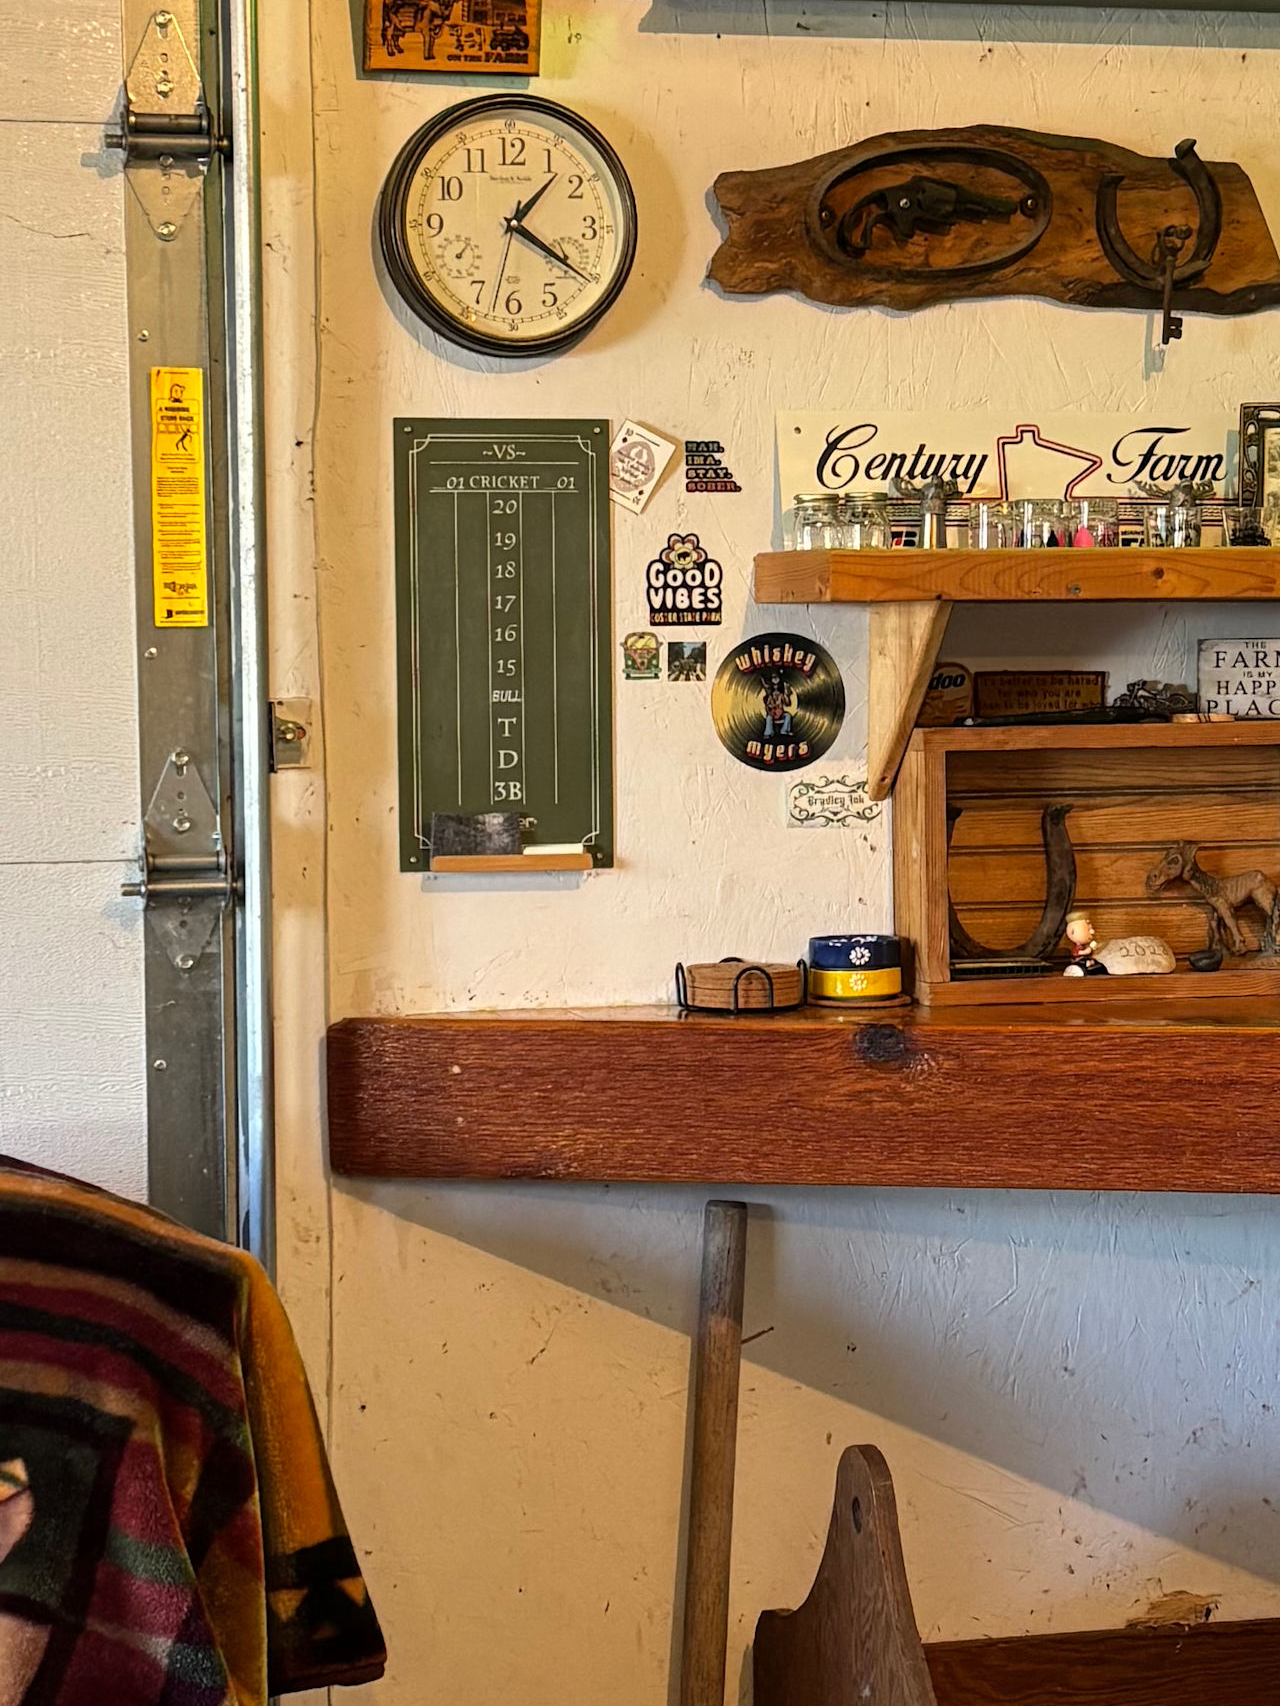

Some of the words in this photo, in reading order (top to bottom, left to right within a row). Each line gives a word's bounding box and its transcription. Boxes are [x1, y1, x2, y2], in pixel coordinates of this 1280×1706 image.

[484, 53, 528, 64] FARM
[463, 148, 488, 173] 11
[498, 137, 526, 166] 12
[543, 149, 555, 173] 1
[437, 176, 463, 201] 10
[568, 175, 584, 199] 2
[426, 213, 444, 238] 9
[581, 215, 597, 240] 3
[470, 280, 486, 305] 7
[505, 290, 522, 315] 6
[542, 282, 558, 307] 5
[816, 423, 988, 493] Century
[1106, 427, 1227, 484] Farm
[470, 476, 540, 489] CRICKET
[492, 499, 517, 514] 20
[495, 532, 516, 550] 19
[495, 561, 516, 578] 18
[649, 561, 720, 588] GOOD
[495, 595, 516, 613] 17
[649, 588, 720, 609] VIBES
[495, 624, 518, 641] 16
[1244, 641, 1266, 649] THE
[497, 659, 516, 676] 15
[734, 643, 816, 676] whiskey
[928, 673, 966, 690] doo
[492, 690, 521, 702] BULL
[498, 718, 517, 736] T
[498, 750, 518, 769] D
[746, 740, 809, 764] myers
[494, 782, 521, 801] 3B
